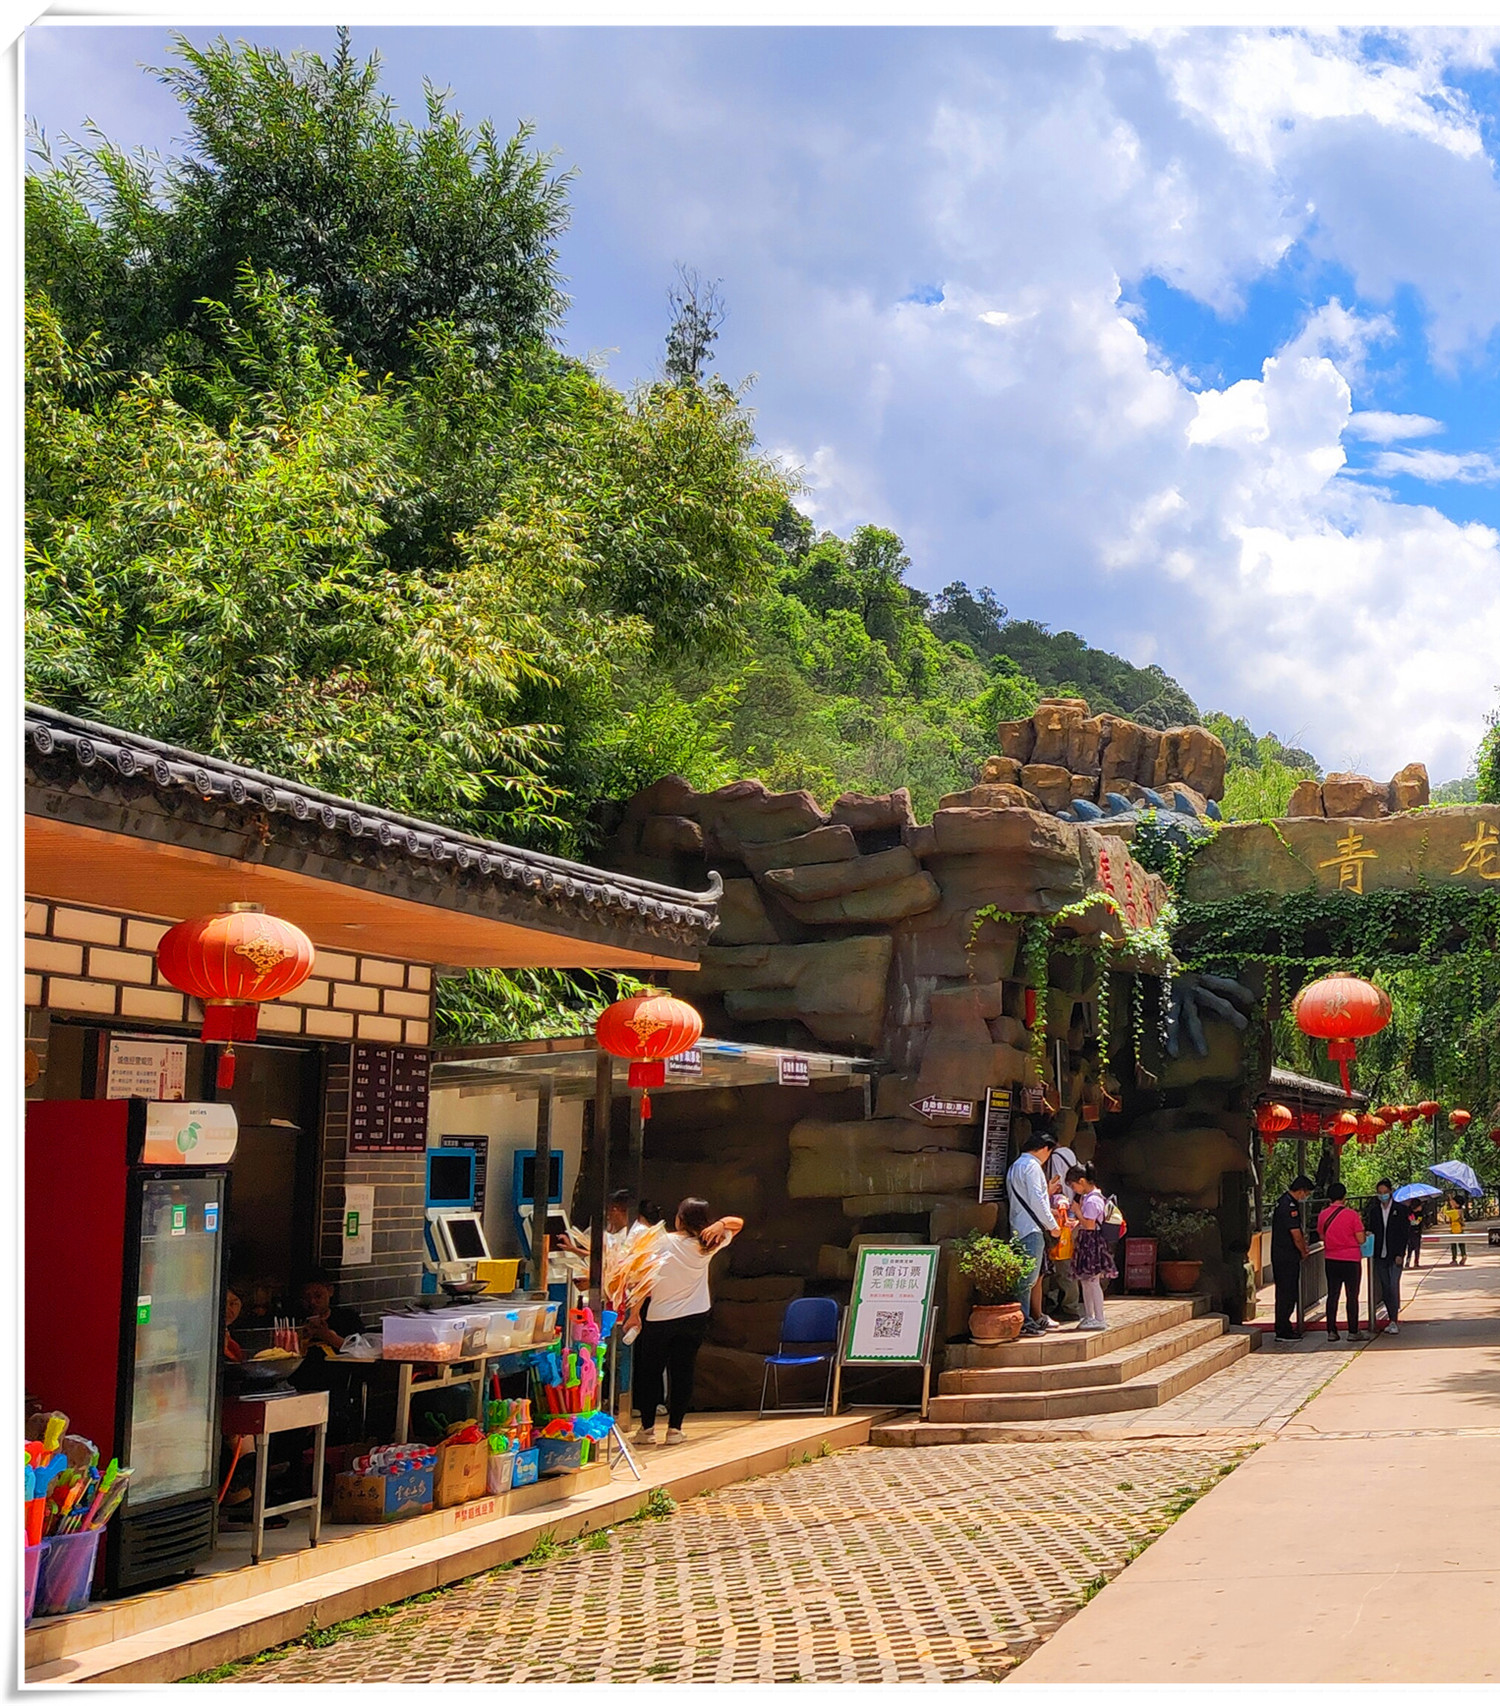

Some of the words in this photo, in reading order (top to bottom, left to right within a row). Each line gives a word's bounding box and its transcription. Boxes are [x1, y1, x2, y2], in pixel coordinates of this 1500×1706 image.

[872, 1266, 921, 1277] 微信订票
[870, 1279, 919, 1289] 无需排队
